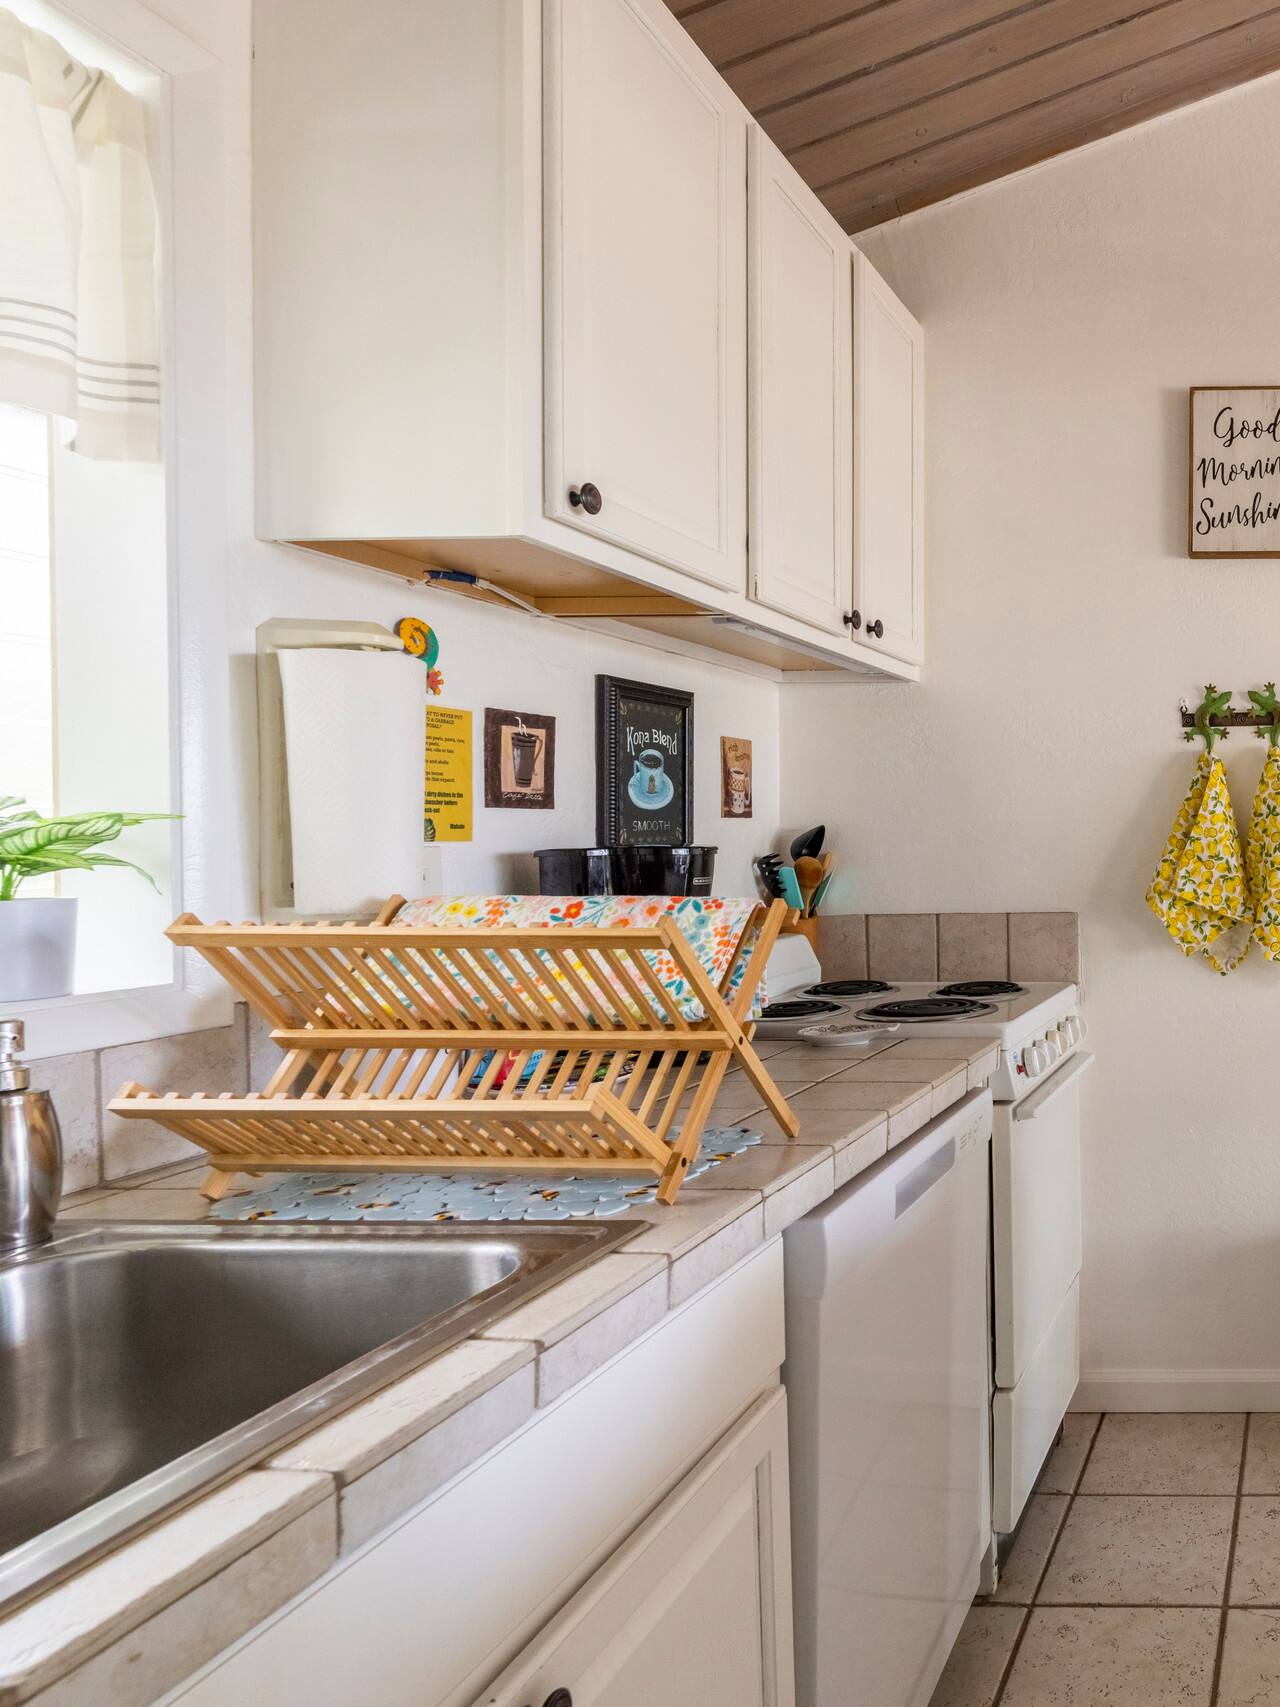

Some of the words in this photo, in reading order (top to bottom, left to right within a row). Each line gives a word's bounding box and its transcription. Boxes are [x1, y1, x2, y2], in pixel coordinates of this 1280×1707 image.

[626, 726, 650, 756] Kona
[651, 728, 678, 756] Blend
[632, 820, 671, 832] SMOOTH
